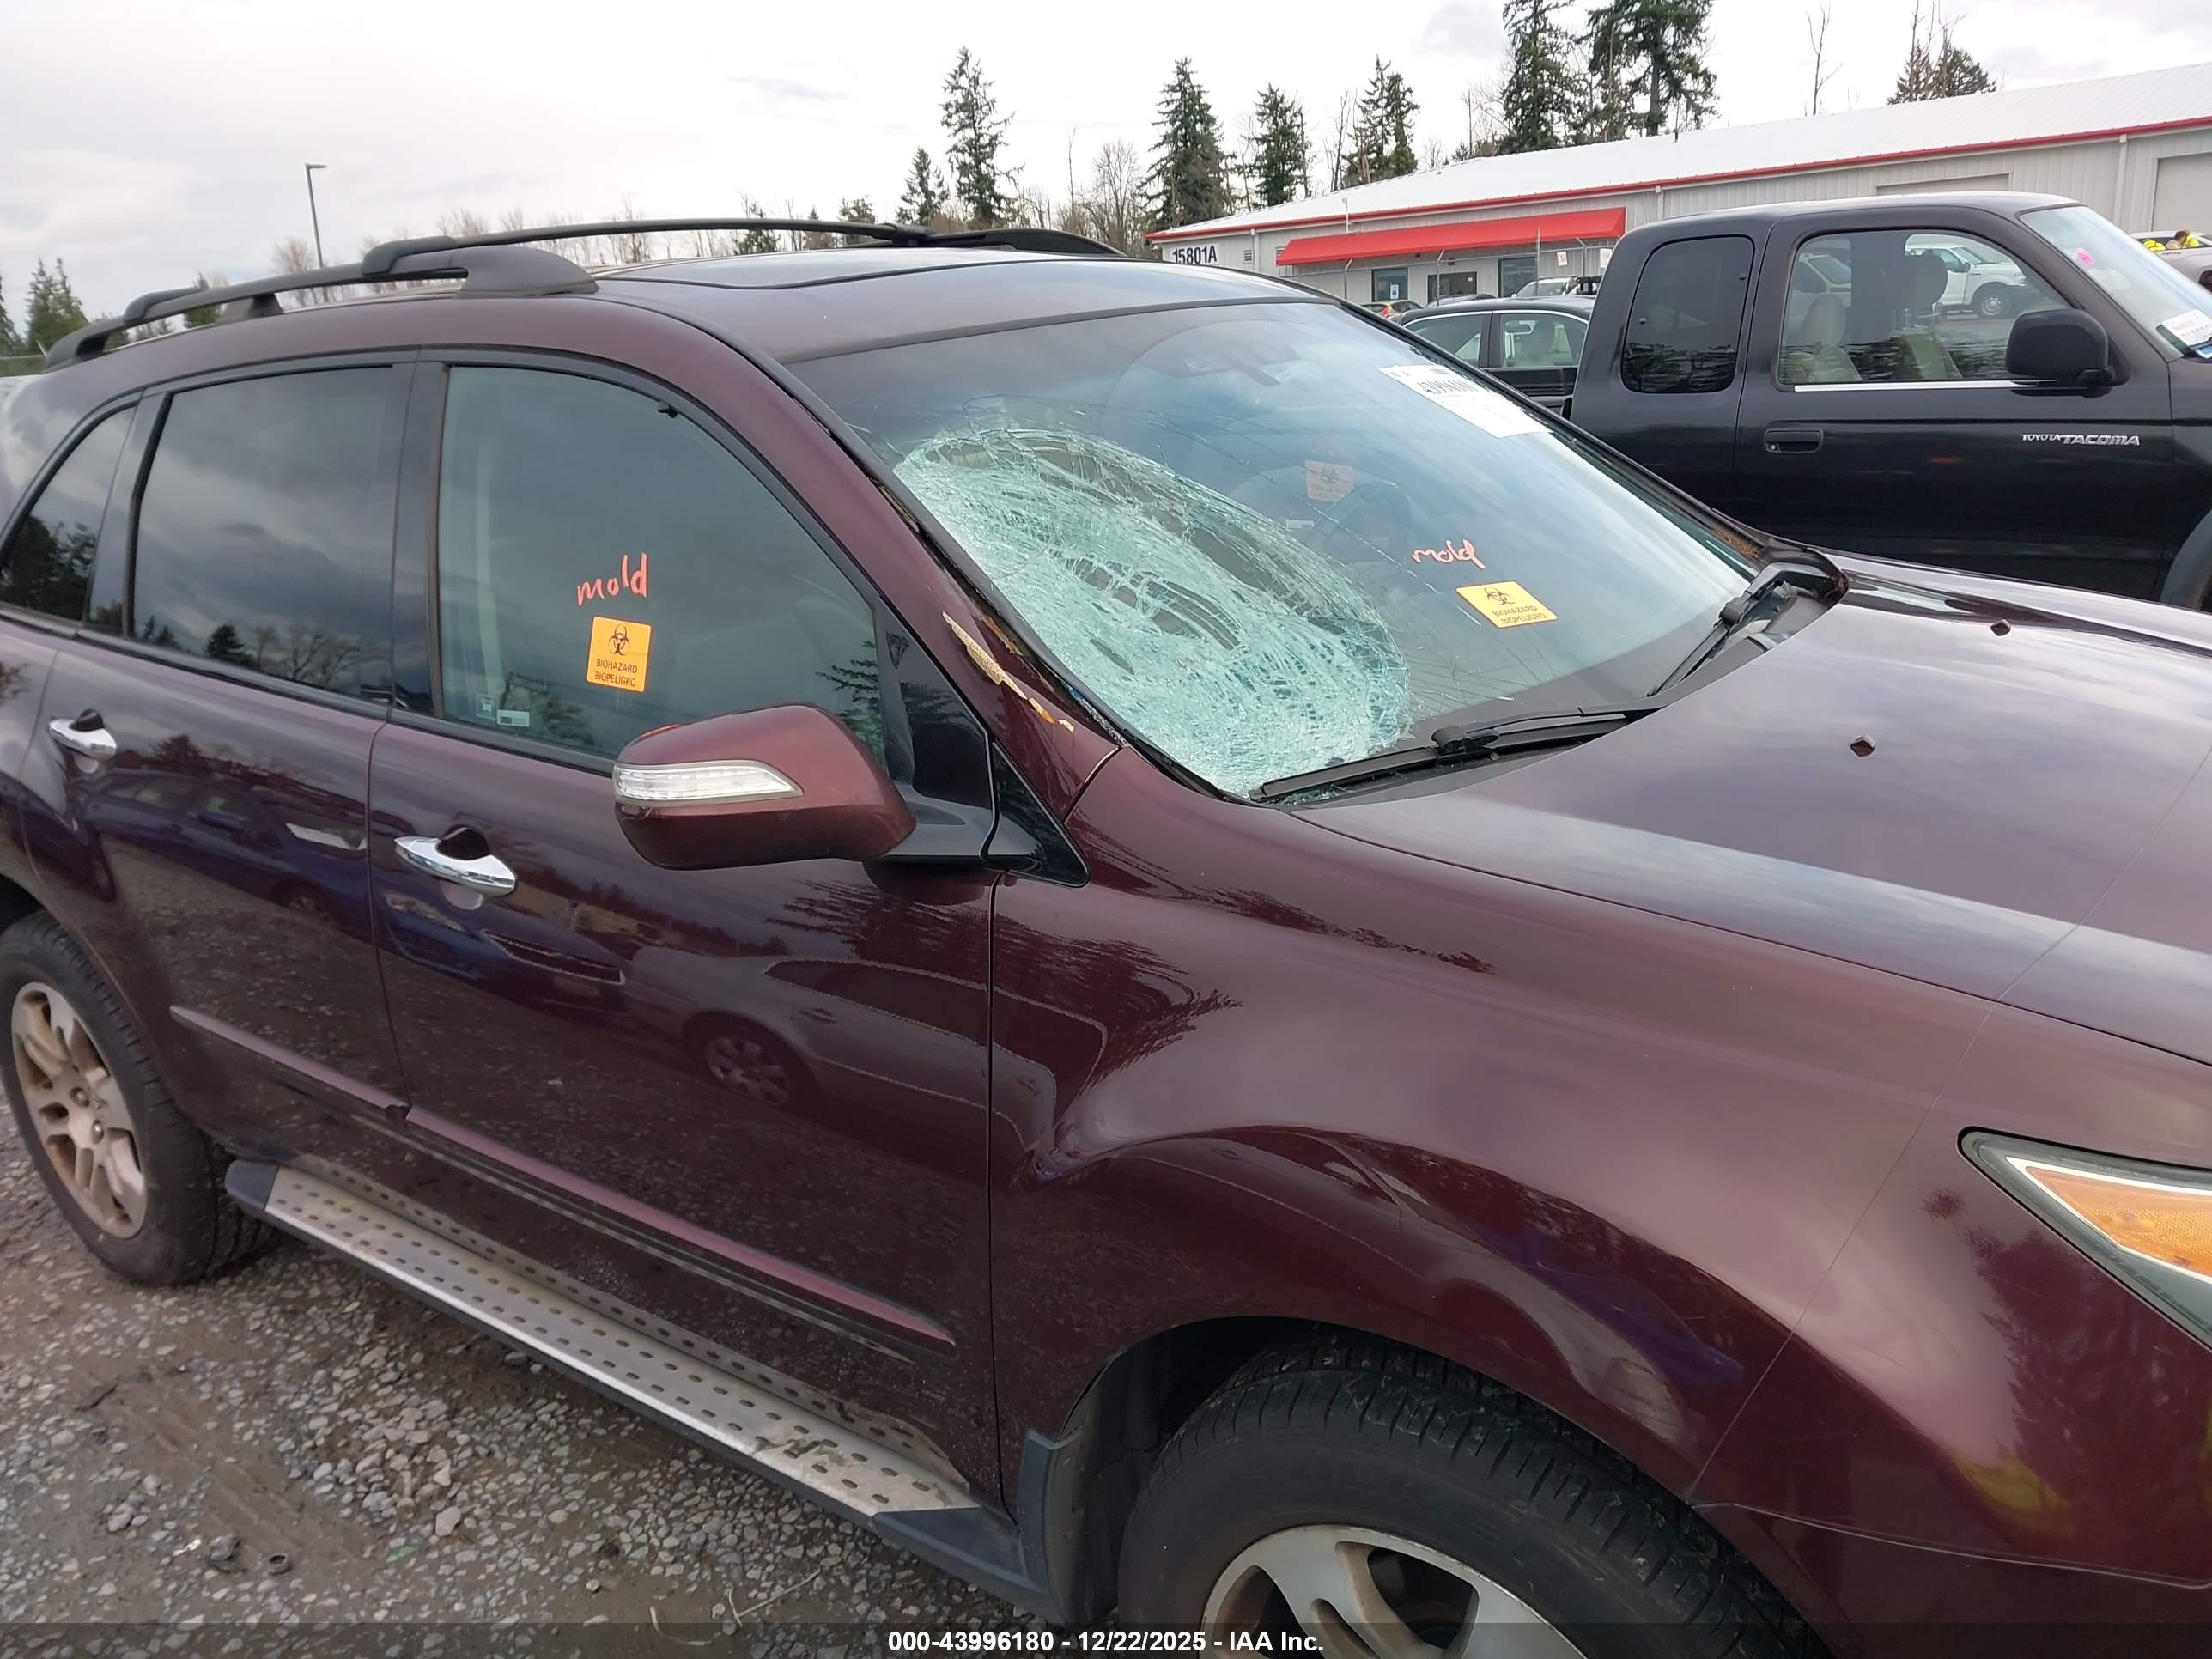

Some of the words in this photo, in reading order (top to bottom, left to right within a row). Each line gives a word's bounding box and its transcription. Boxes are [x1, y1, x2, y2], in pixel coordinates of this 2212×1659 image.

[1172, 245, 1218, 264] 15801A
[2061, 434, 2140, 446] TACOMA
[1411, 538, 1486, 569] mold
[577, 552, 648, 606] mold
[596, 658, 638, 674] BIOHAZARD
[594, 671, 636, 687] BIOPELIGRO
